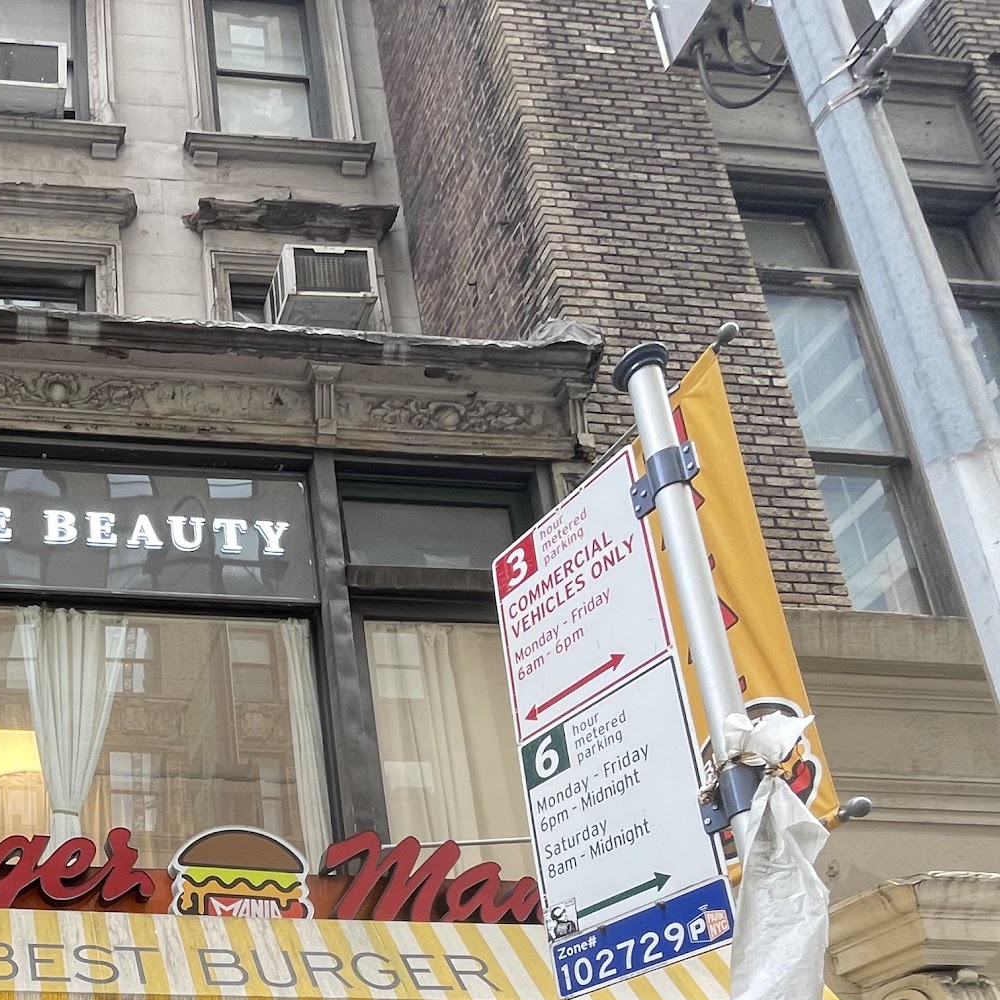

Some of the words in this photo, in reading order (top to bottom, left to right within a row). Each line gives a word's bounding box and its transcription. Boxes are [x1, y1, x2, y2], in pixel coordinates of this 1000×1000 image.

[44, 509, 290, 556] BEAUTY
[540, 514, 564, 540] hour
[542, 508, 587, 552] metered
[544, 526, 584, 567] parking
[506, 547, 528, 587] 3
[508, 531, 613, 619] COMMERCIAL
[511, 574, 586, 638] VEHICLES
[591, 533, 635, 579] ONLY
[515, 624, 560, 665] Monday
[571, 588, 611, 623] Friday
[517, 654, 545, 681] 6am
[555, 626, 584, 659] 6pm
[572, 712, 600, 736] hour
[574, 710, 627, 749] metered
[534, 735, 560, 779] 6
[577, 728, 624, 766] parking
[537, 776, 590, 814] Monday
[604, 744, 649, 778] Friday
[540, 808, 569, 833] 6pm
[581, 769, 641, 811] Midnight
[544, 818, 607, 860] Saturday
[548, 857, 578, 879] 8am
[589, 818, 651, 858] Midnight
[210, 896, 283, 918] MANIA
[708, 919, 729, 938] NYC
[197, 948, 502, 992] BURGER
[557, 936, 597, 961] Zone#
[561, 921, 685, 991] 102729
